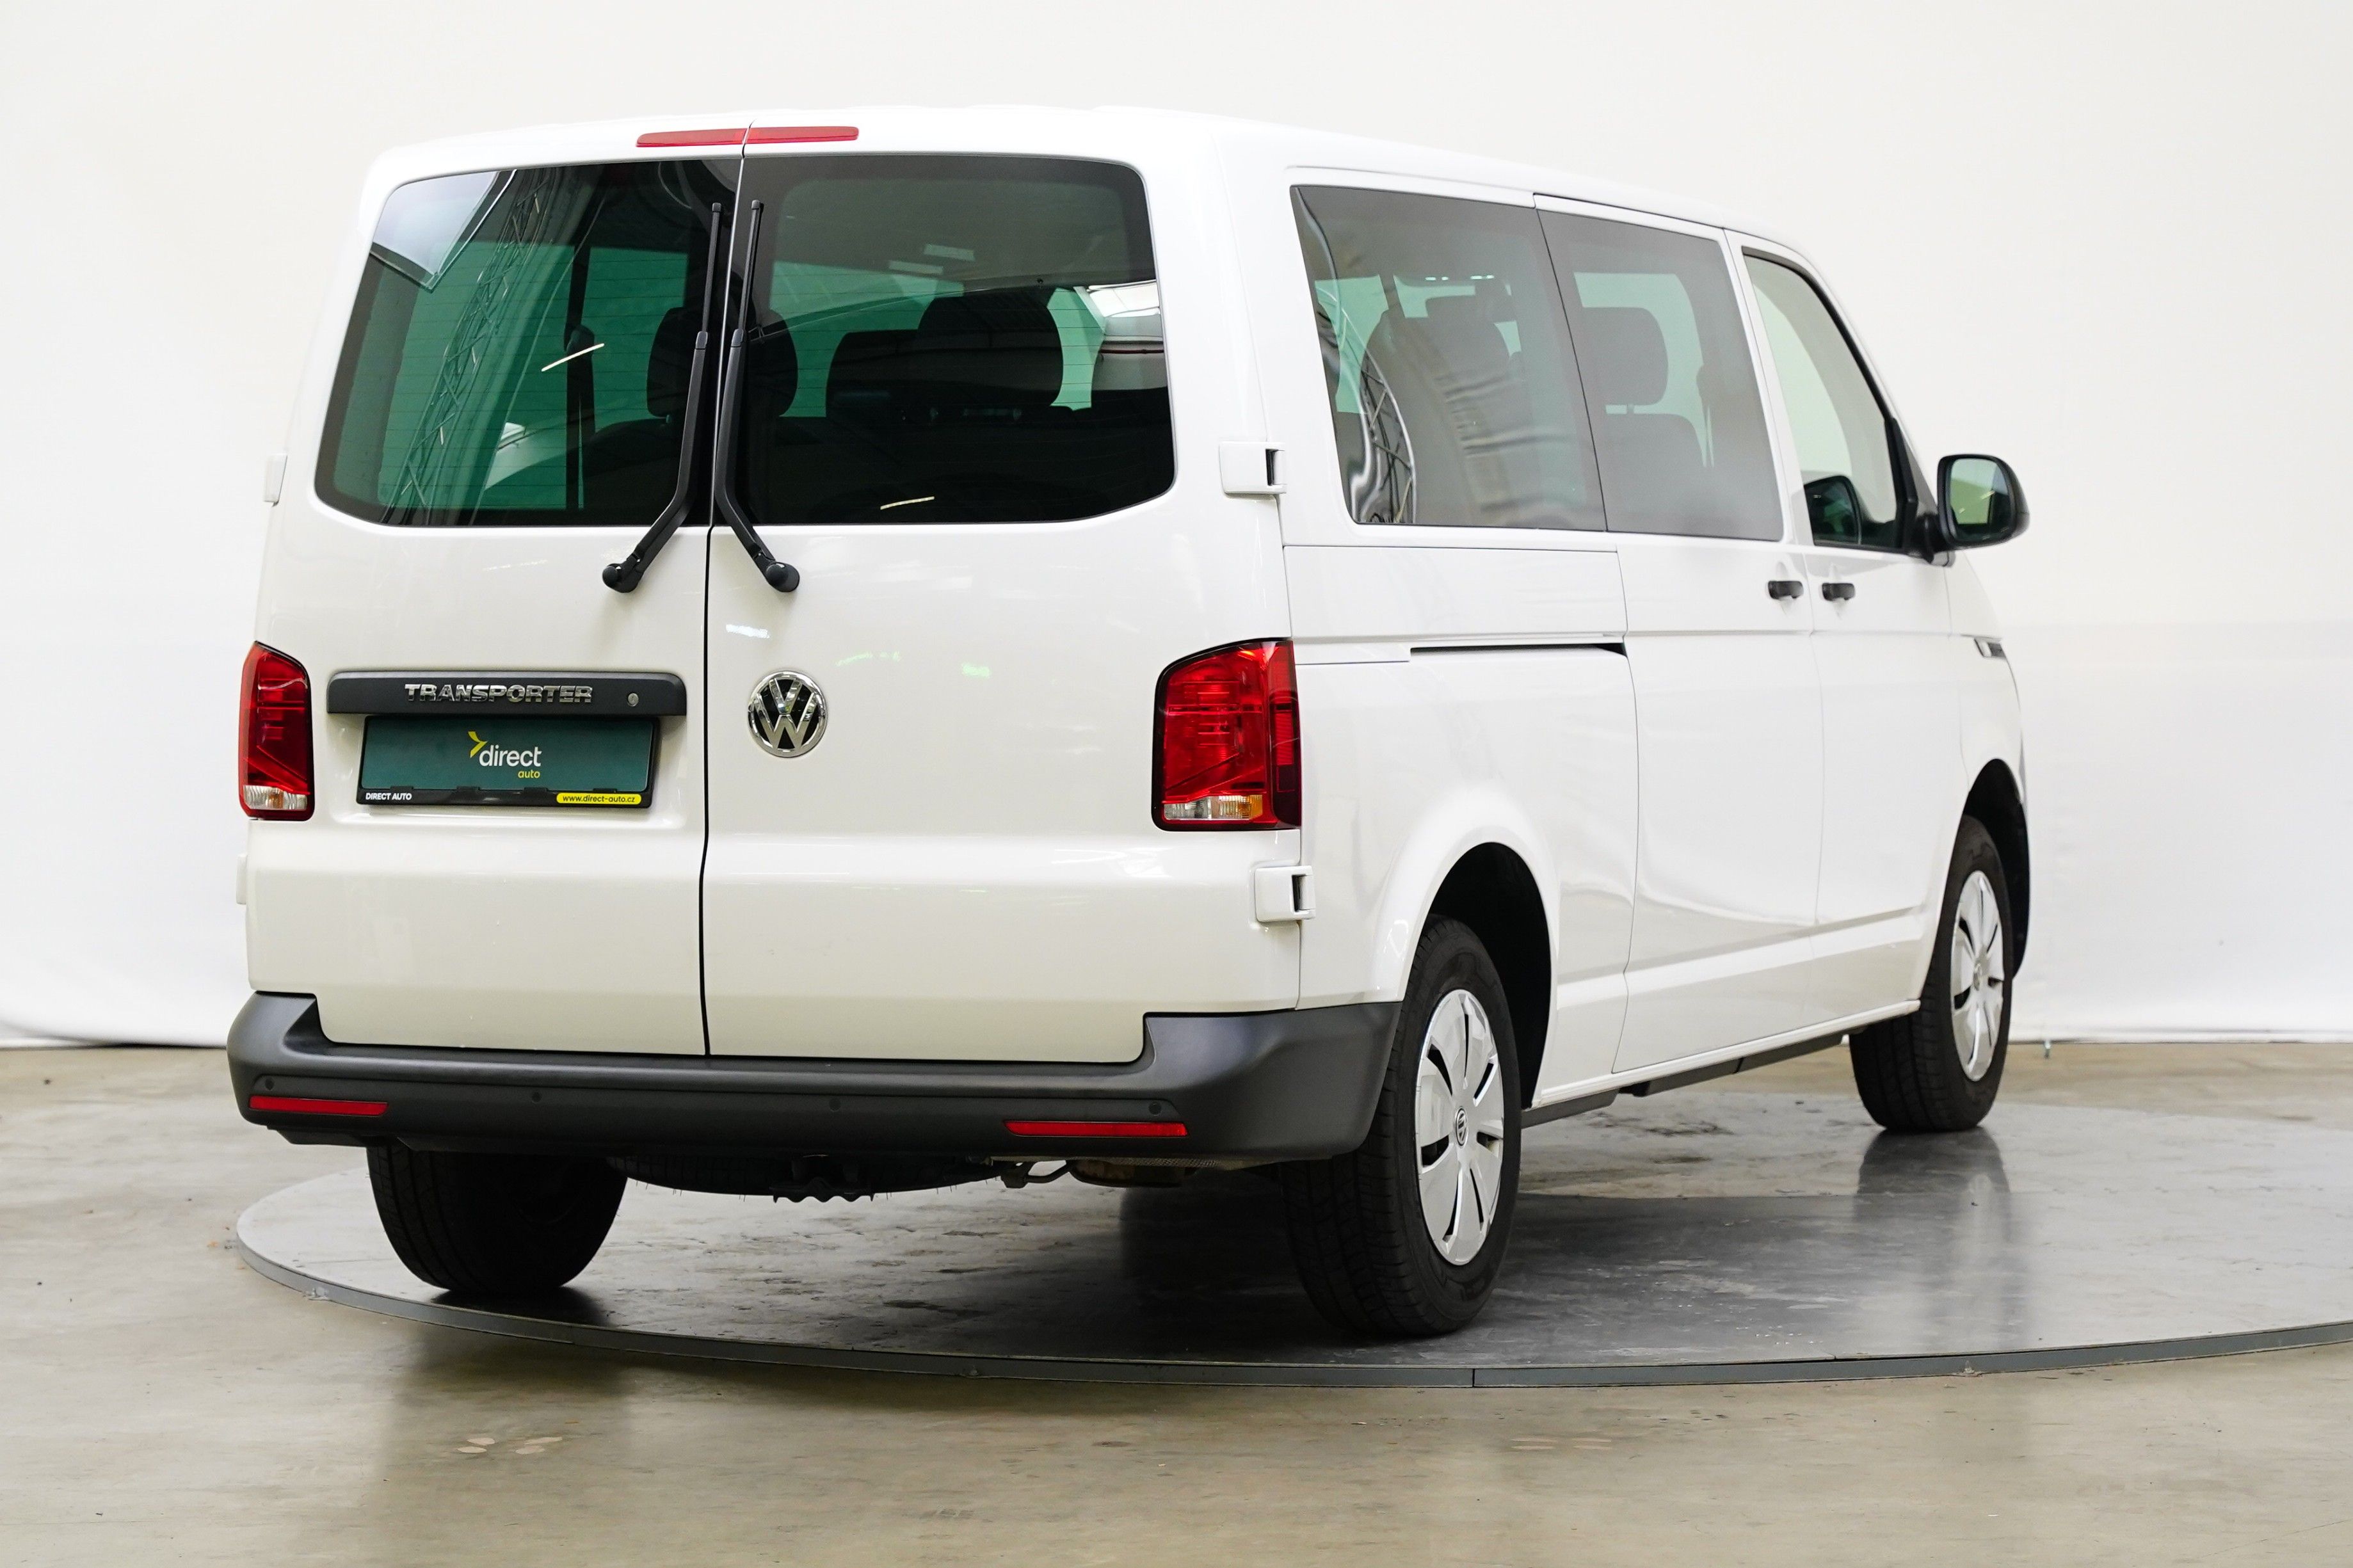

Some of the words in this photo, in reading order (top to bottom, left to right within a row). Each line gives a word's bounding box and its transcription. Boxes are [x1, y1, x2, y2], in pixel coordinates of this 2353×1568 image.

[404, 684, 593, 703] TRANSPORTER
[479, 744, 542, 767] direct
[517, 769, 541, 779] auto
[365, 792, 392, 801] DIRECT
[391, 792, 412, 801] AUTO
[563, 794, 636, 803] www.direct-auto.cz
